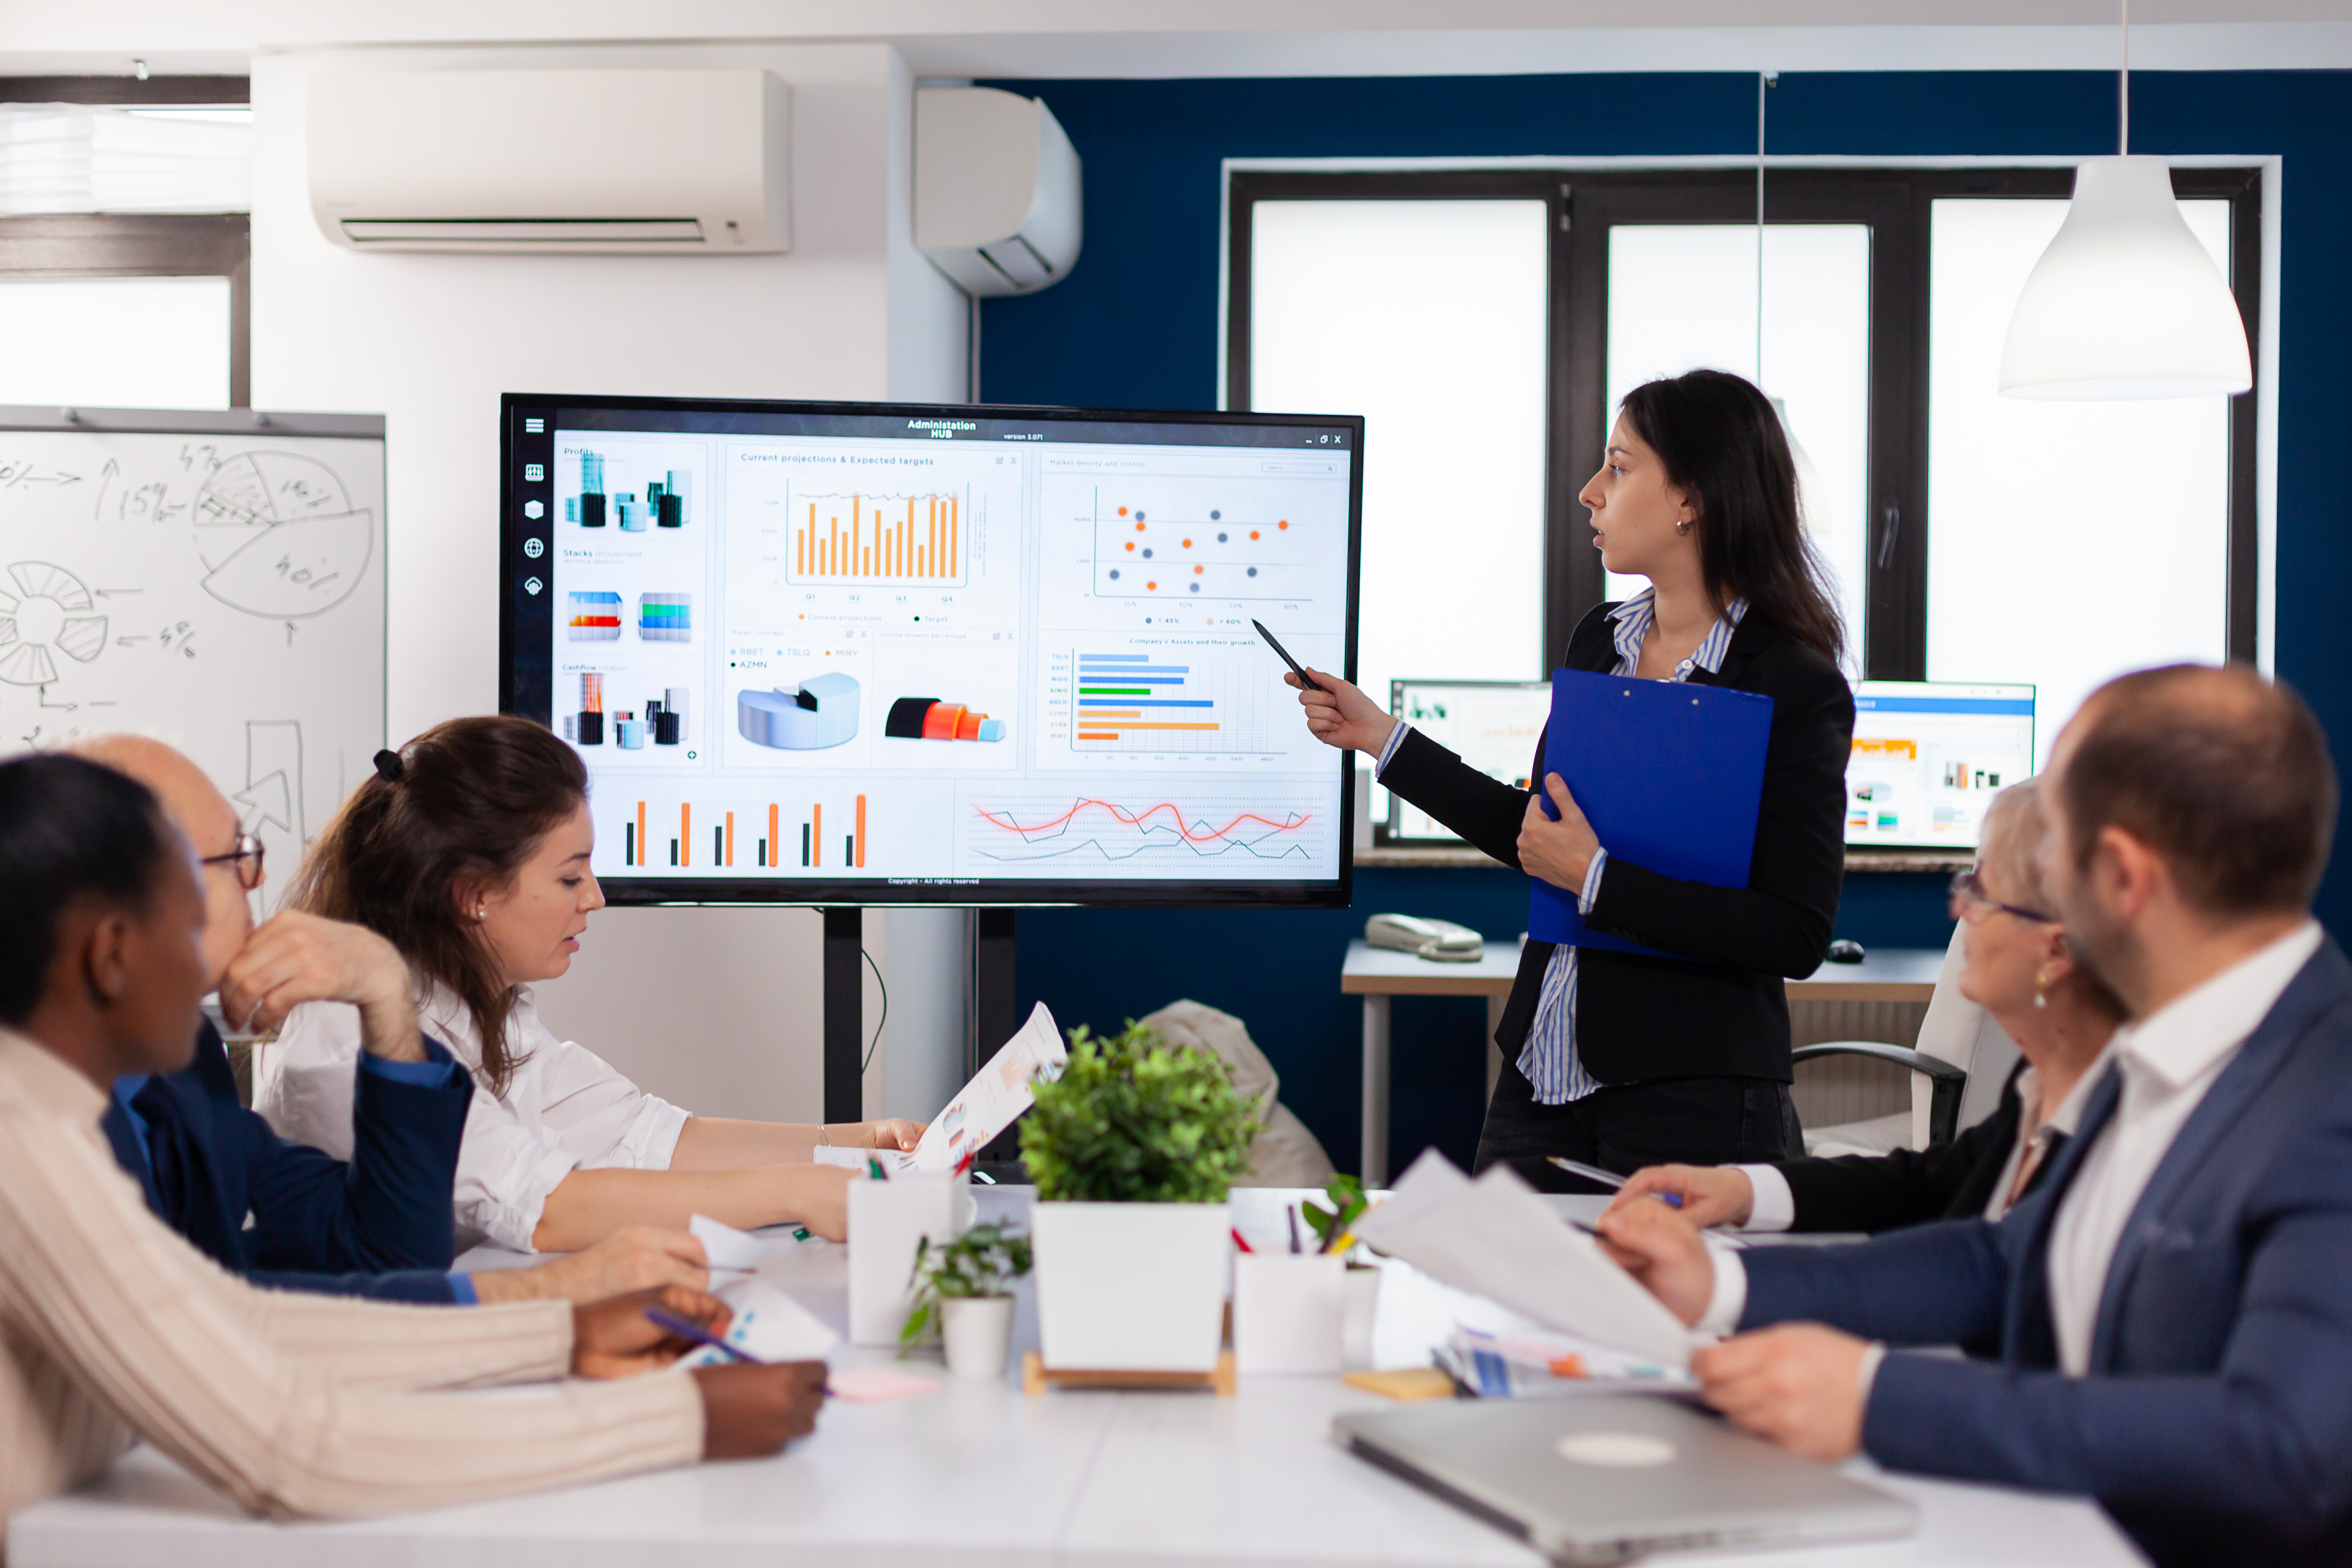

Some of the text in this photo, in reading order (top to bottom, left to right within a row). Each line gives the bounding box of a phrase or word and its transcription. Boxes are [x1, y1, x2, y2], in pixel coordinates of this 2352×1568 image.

[907, 420, 977, 430] Administation
[931, 430, 953, 438] HUB
[563, 446, 593, 456] Profits
[741, 453, 777, 462] Current
[781, 455, 836, 464] projections
[850, 456, 895, 464] Expected
[899, 458, 934, 466] targets
[740, 647, 763, 656] BBET
[787, 648, 810, 657] TSLQ
